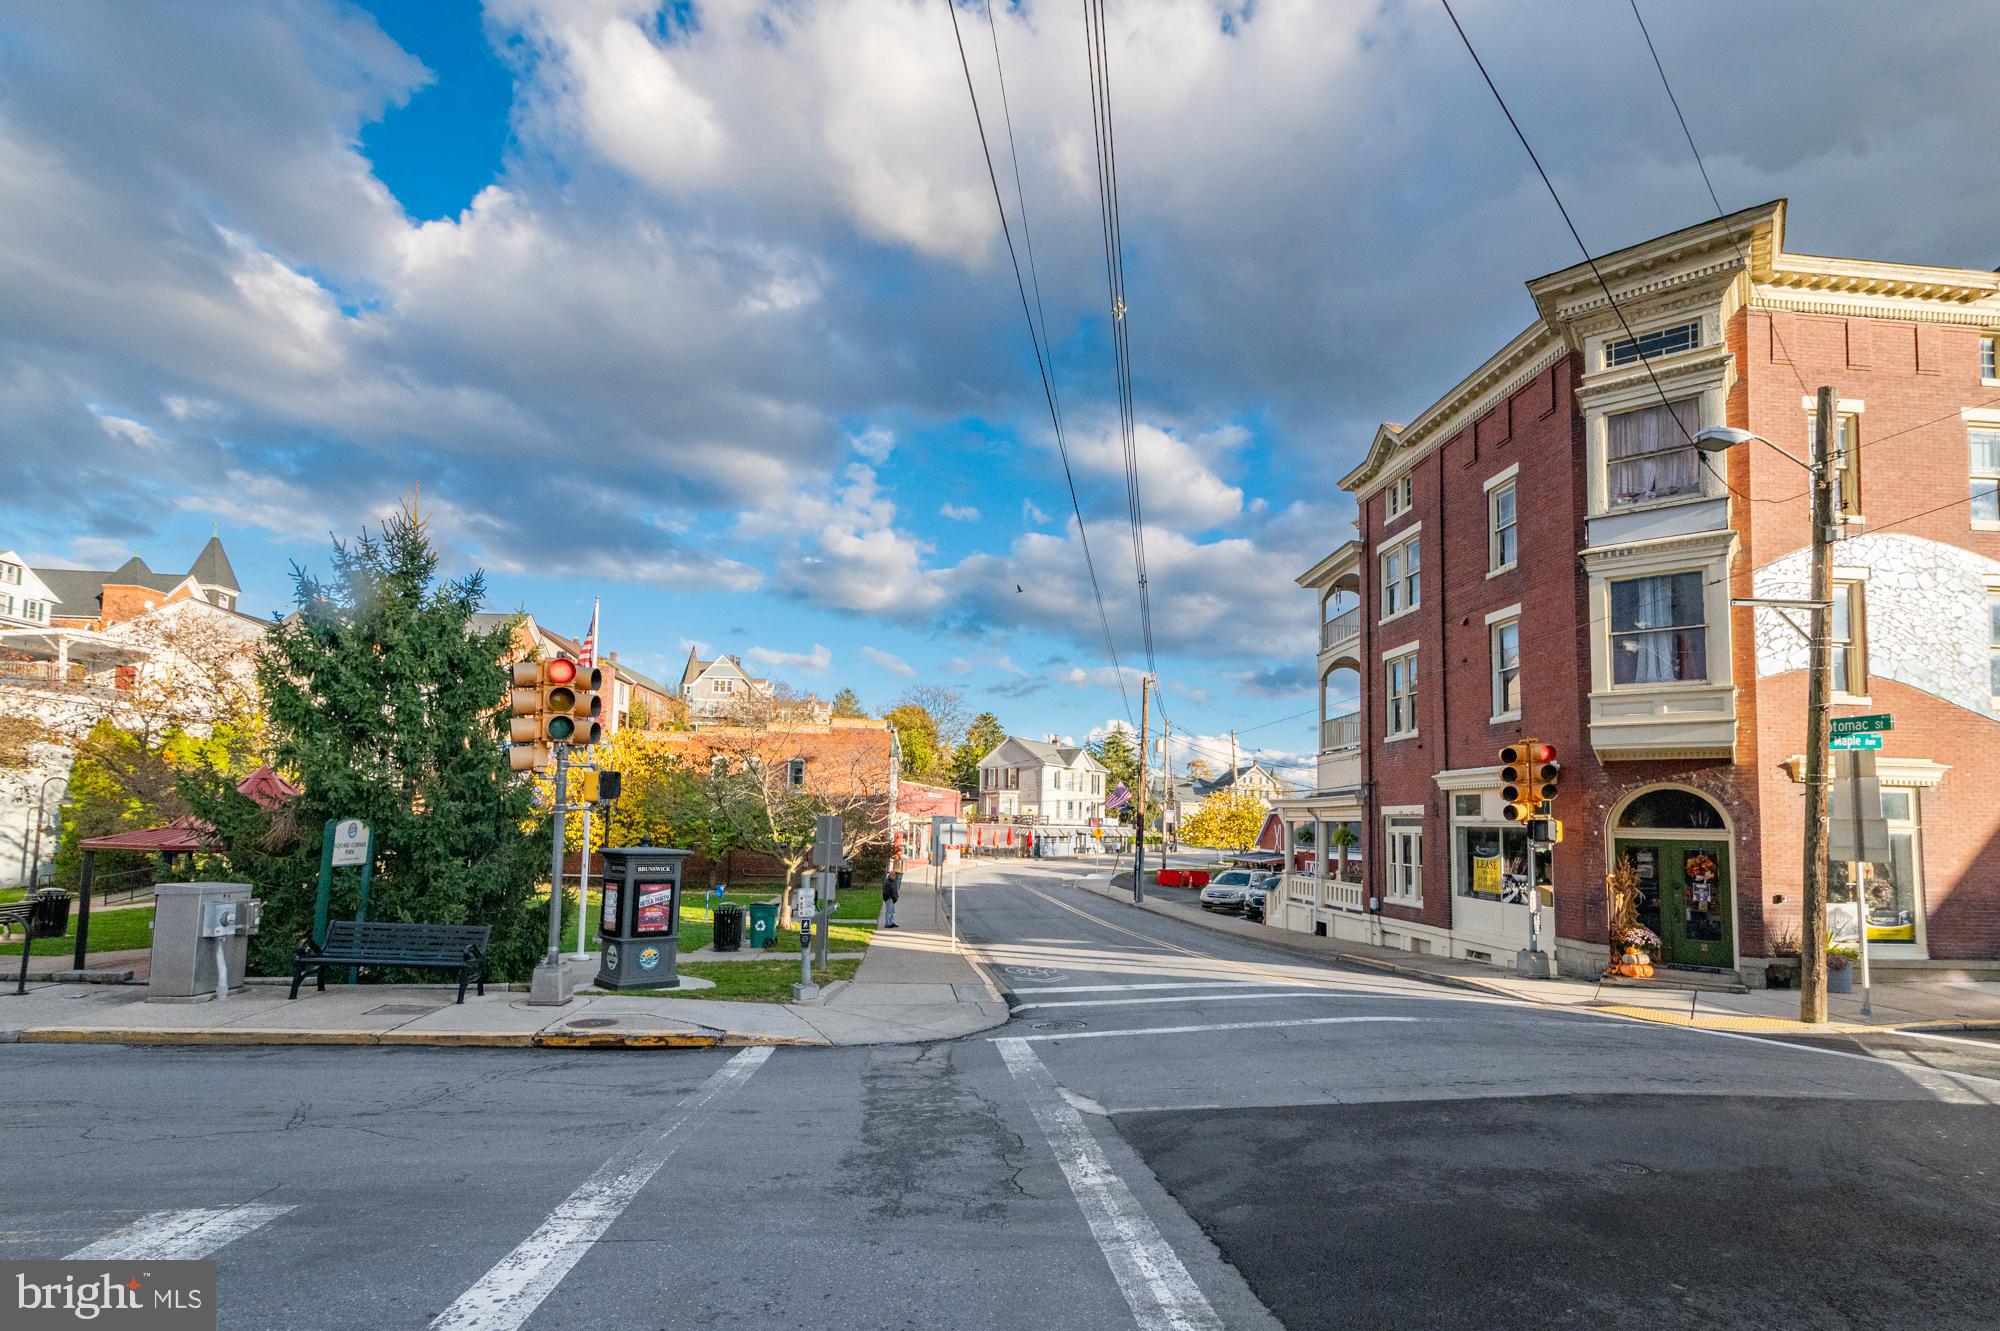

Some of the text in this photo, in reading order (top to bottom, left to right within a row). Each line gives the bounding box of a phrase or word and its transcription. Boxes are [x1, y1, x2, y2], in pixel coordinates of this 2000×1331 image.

[1874, 720, 1885, 729] St
[1833, 736, 1861, 749] Maple
[1476, 859, 1498, 870] LEASE
[655, 895, 670, 903] PARTY
[1700, 943, 1708, 952] 2
